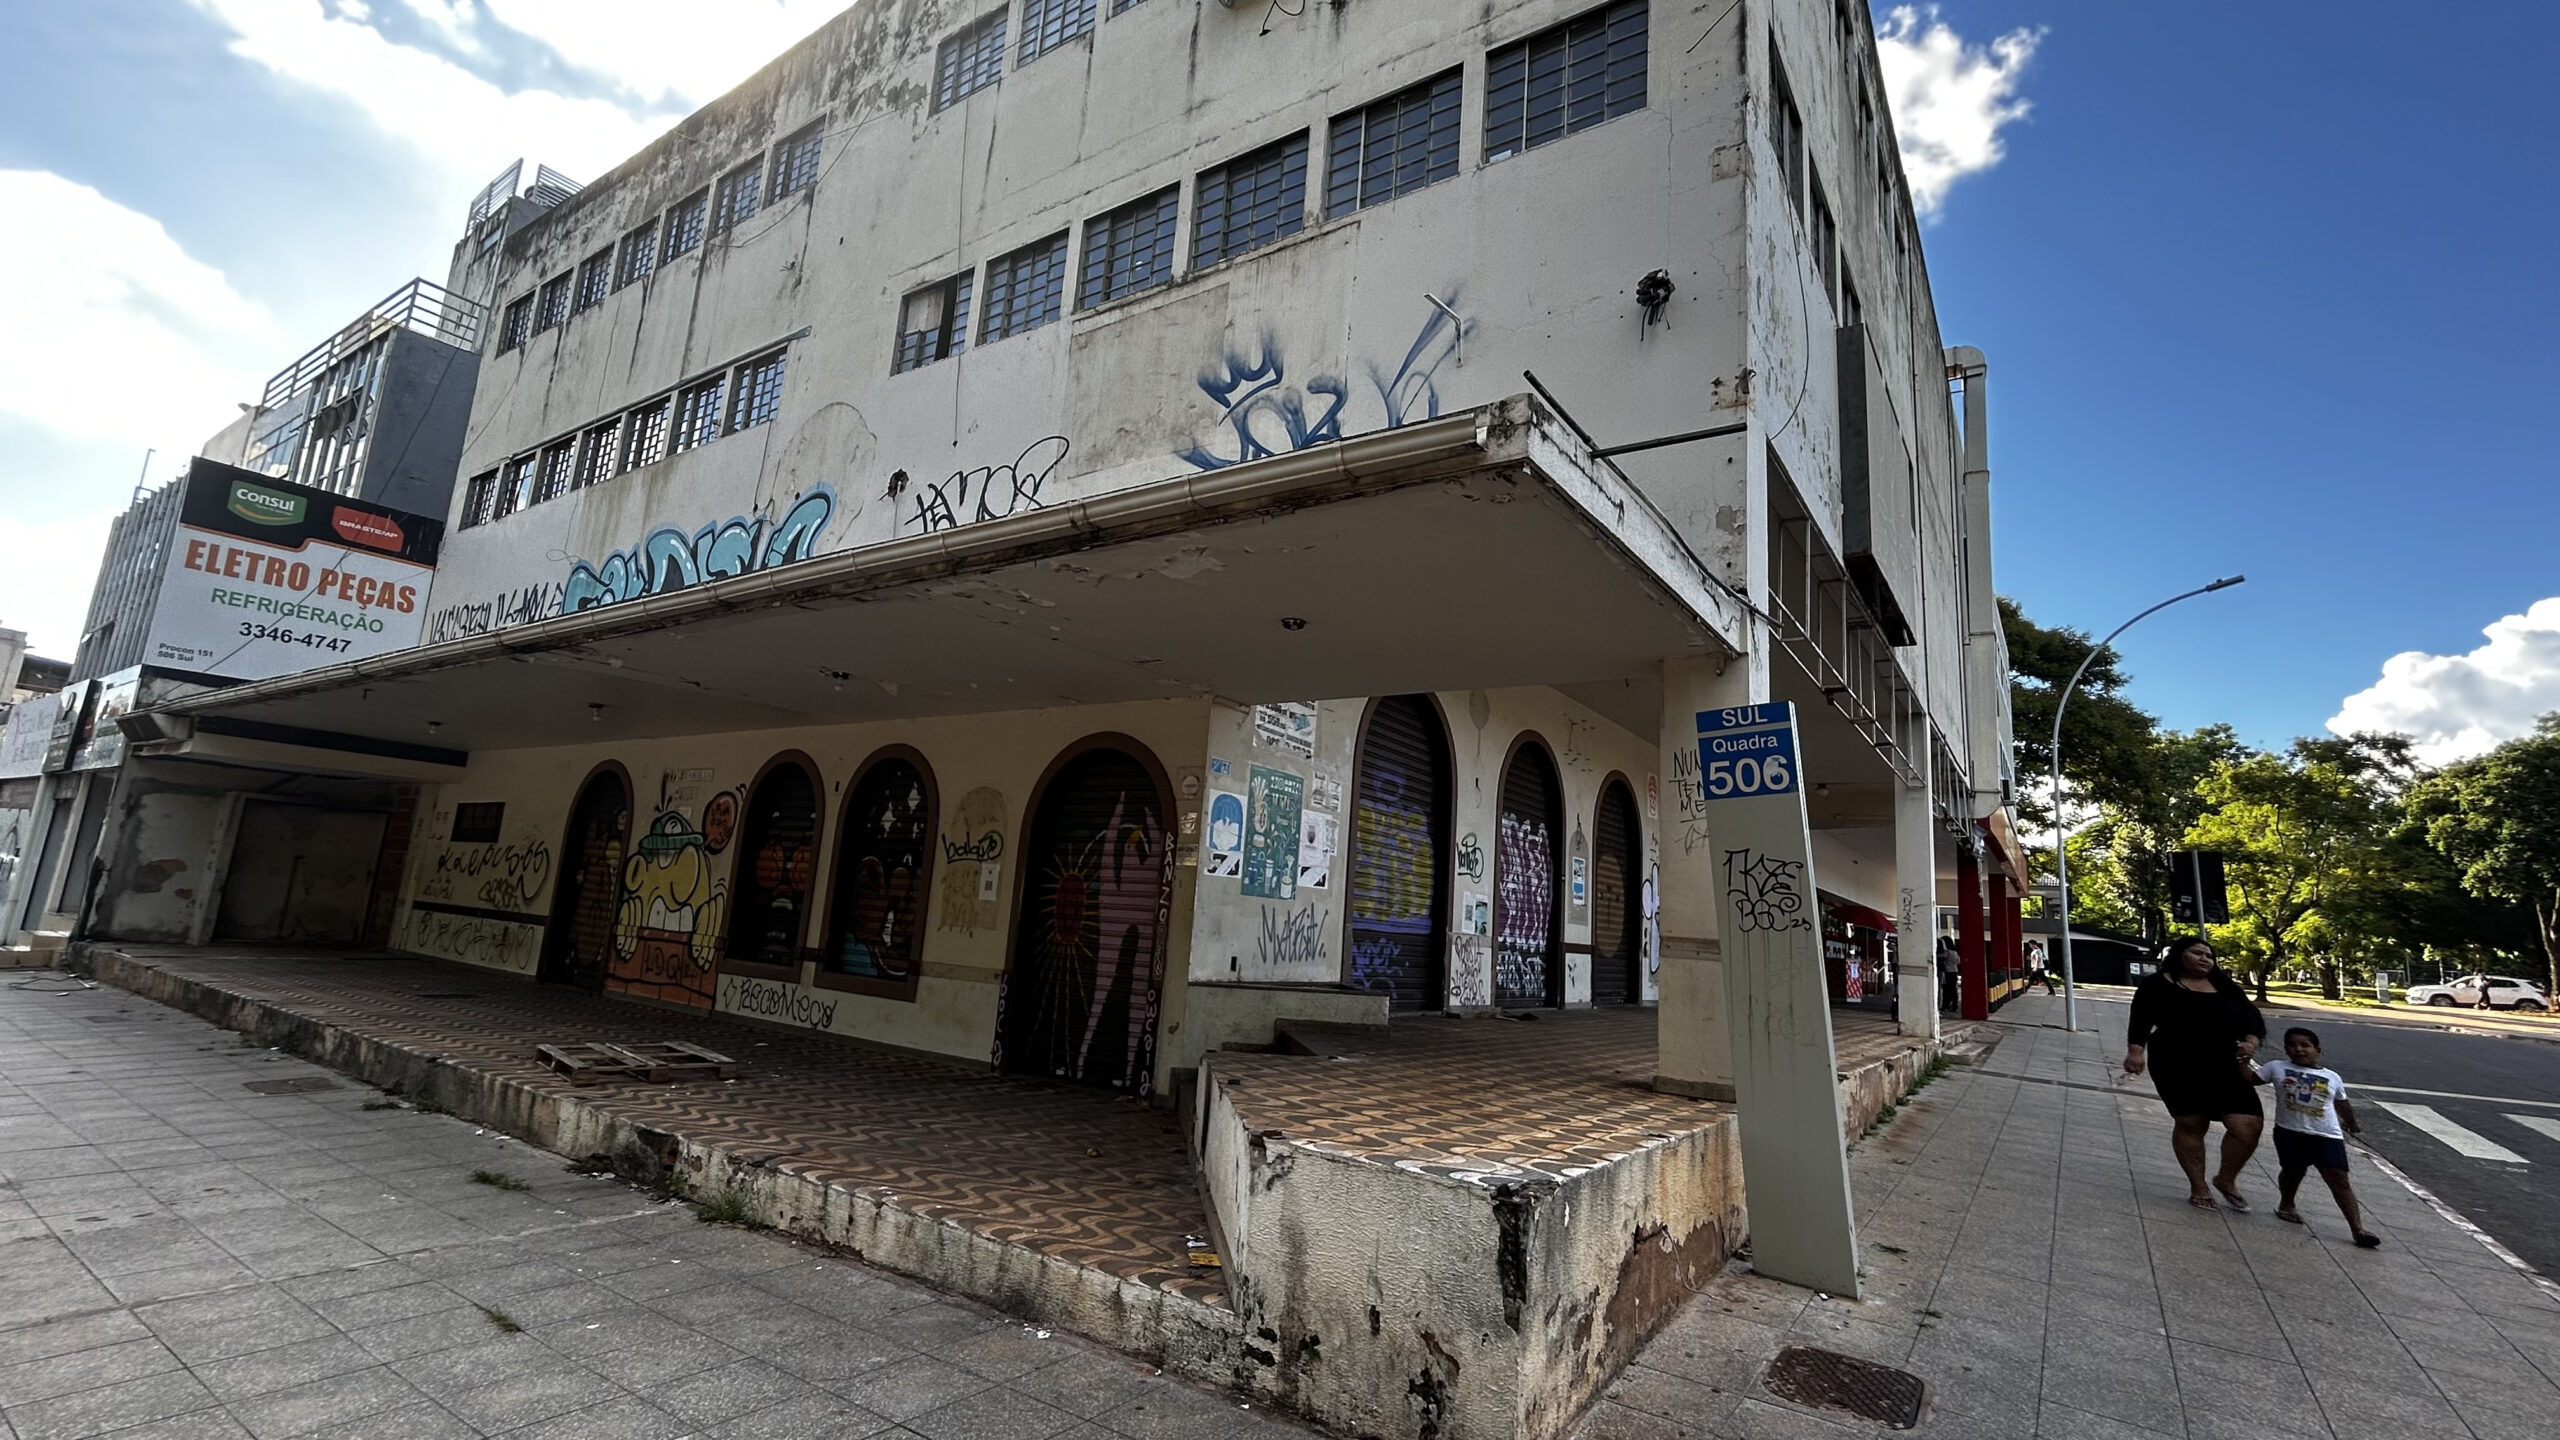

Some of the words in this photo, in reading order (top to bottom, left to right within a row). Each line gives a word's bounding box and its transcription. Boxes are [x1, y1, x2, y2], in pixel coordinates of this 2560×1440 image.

[339, 519, 398, 539] BRASTEMP
[184, 539, 310, 592] ELETRO
[318, 568, 416, 614] PEÇAS
[210, 588, 384, 634] REFRIGERAÇÃO
[159, 643, 194, 655] Procon
[198, 649, 213, 657] 151
[239, 621, 352, 653] 3346-4747
[1721, 707, 1768, 727] SUL
[1712, 735, 1778, 754] Quadra
[1708, 755, 1790, 795] 506
[1159, 832, 1174, 922] BANZO
